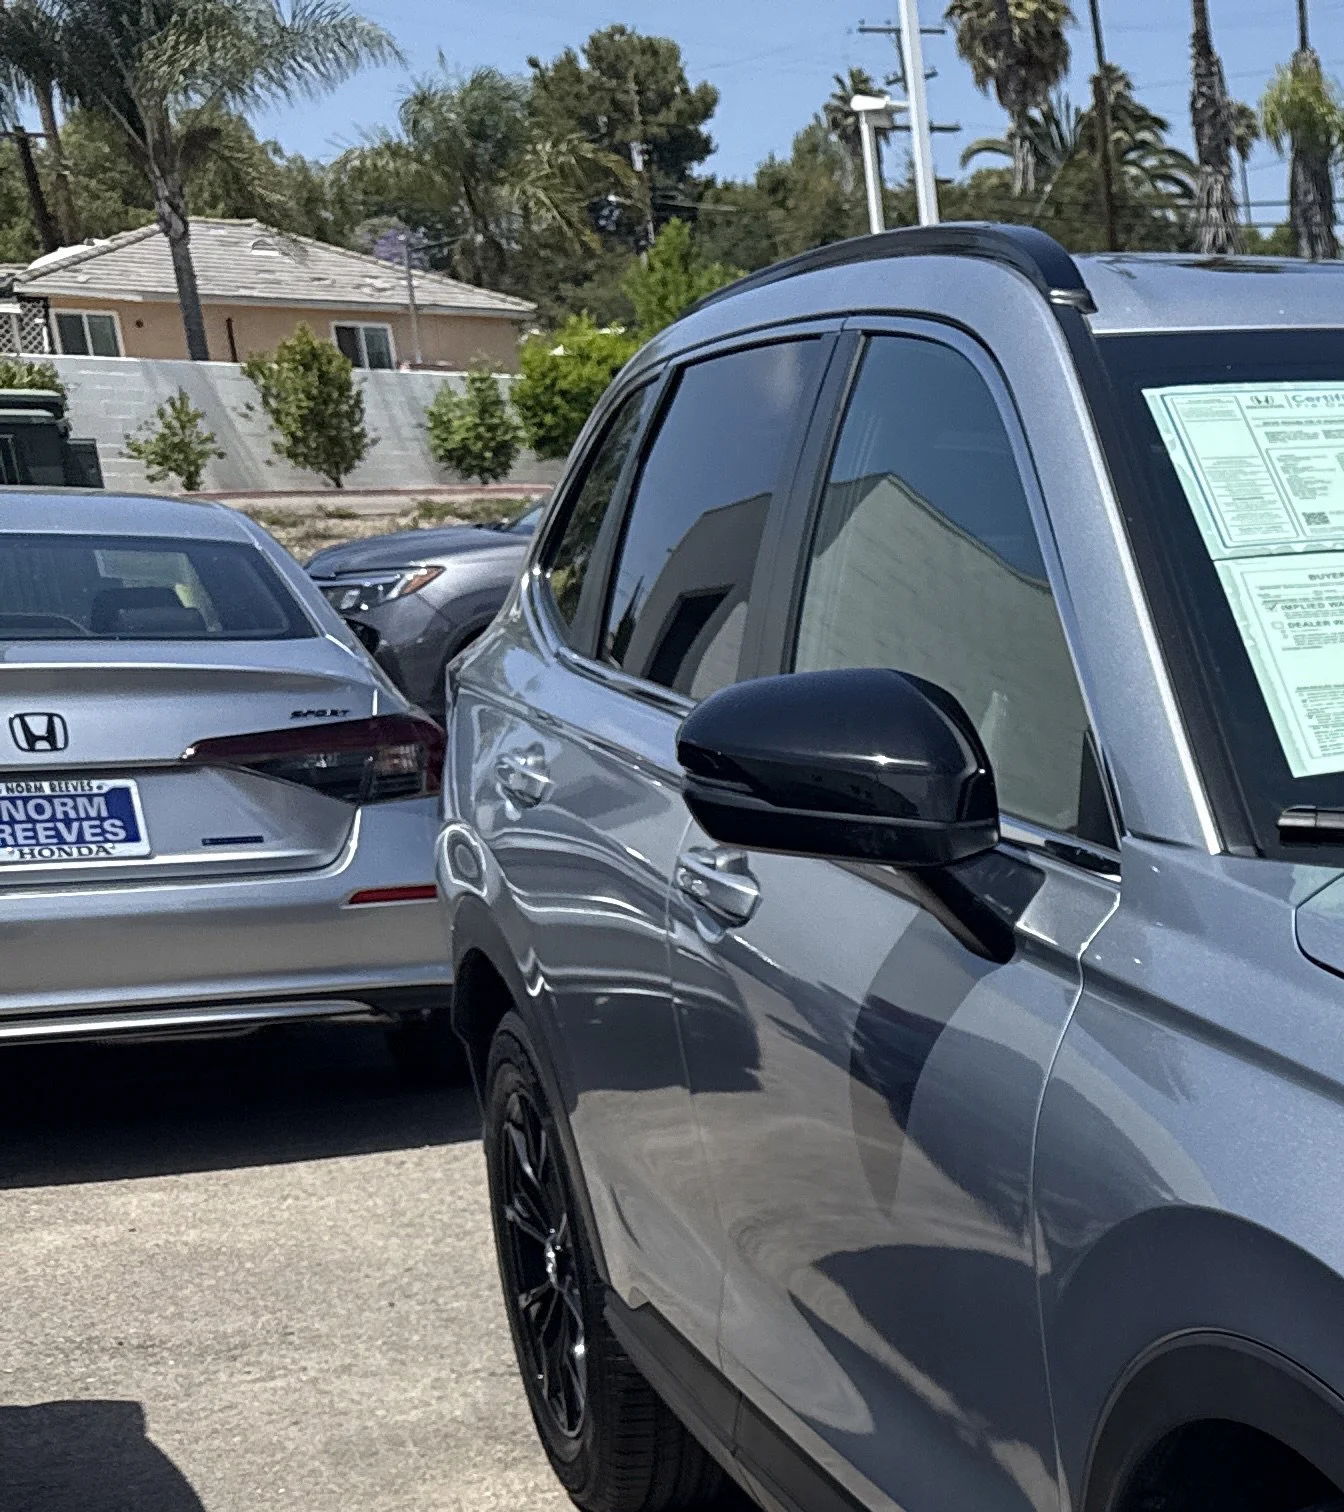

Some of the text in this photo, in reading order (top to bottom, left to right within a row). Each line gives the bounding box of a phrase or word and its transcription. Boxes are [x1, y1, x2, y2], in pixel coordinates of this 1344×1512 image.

[5, 780, 94, 795] NORM REEVES
[0, 796, 127, 846] NORM REEVES
[18, 844, 114, 860] HONDA
